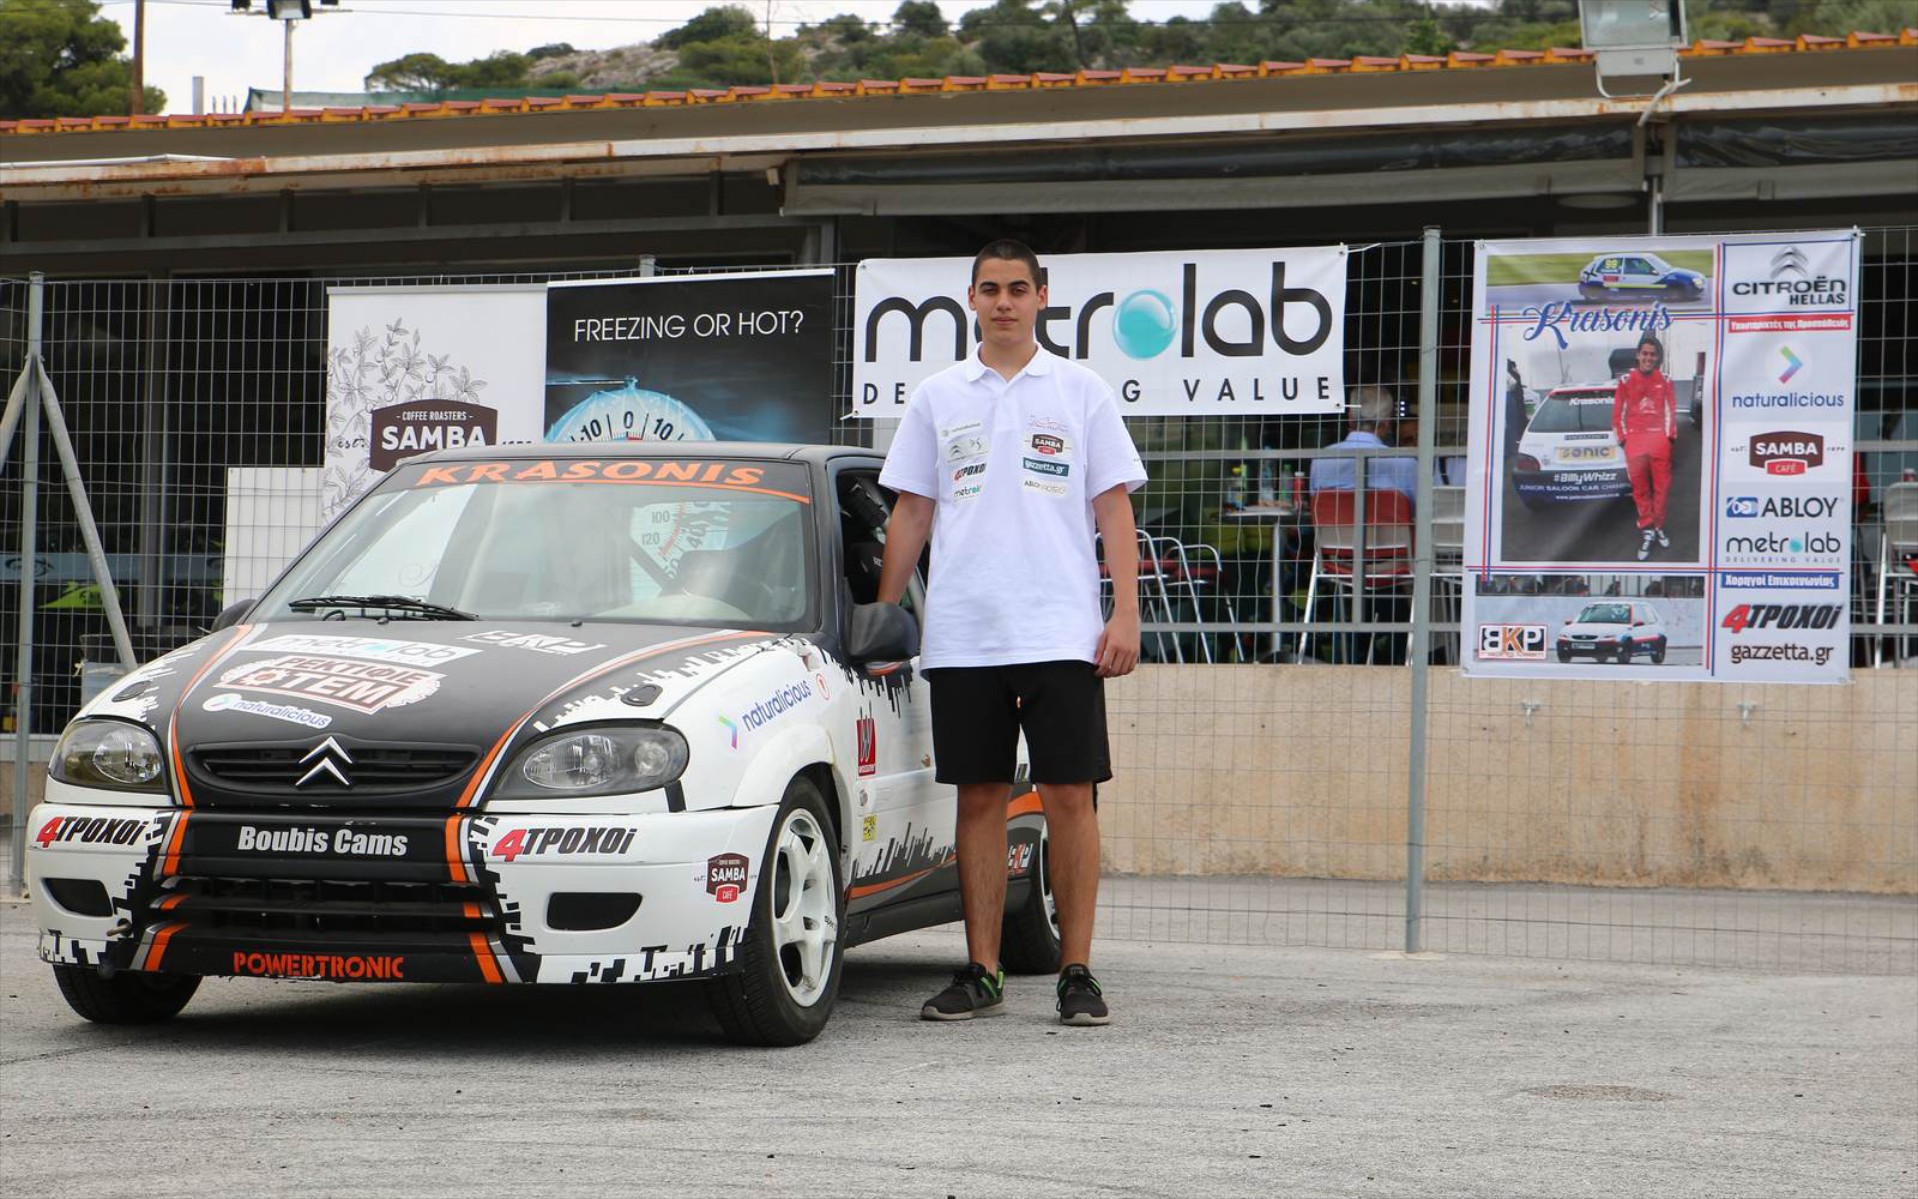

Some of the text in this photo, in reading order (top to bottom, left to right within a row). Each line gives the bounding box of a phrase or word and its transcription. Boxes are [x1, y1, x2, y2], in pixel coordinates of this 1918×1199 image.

[1733, 276, 1846, 296] CITROËN
[1789, 292, 1845, 306] HELLAS
[865, 261, 1333, 363] mtrolab
[574, 309, 804, 343] FREEZING OR HOT?
[1523, 301, 1673, 349] Krasonis
[1183, 377, 1330, 403] VALUE
[1731, 391, 1844, 408] naturalicious
[402, 411, 467, 421] COFFEE ROASTERS
[623, 410, 634, 429] 0
[381, 426, 487, 451] SAMBA
[653, 418, 674, 441] 10
[1034, 438, 1061, 449] SAMBA
[1755, 442, 1819, 456] SAMBA
[415, 461, 766, 487] KRASONIS
[651, 510, 671, 524] 100
[1761, 497, 1838, 518] ABLOY
[642, 532, 660, 546] 120
[1726, 531, 1841, 553] metrolab
[1731, 643, 1834, 666] gazzetta.gr
[278, 657, 427, 685] ΡΕΚΤΙΦΙΕ
[284, 674, 399, 707] ΤΕΜ
[232, 700, 330, 727] naturalicious
[741, 677, 812, 731] naturalicious
[237, 826, 408, 856] Boubis Cams
[711, 867, 746, 882] SAMBA
[233, 951, 404, 979] POWERTRONIC
